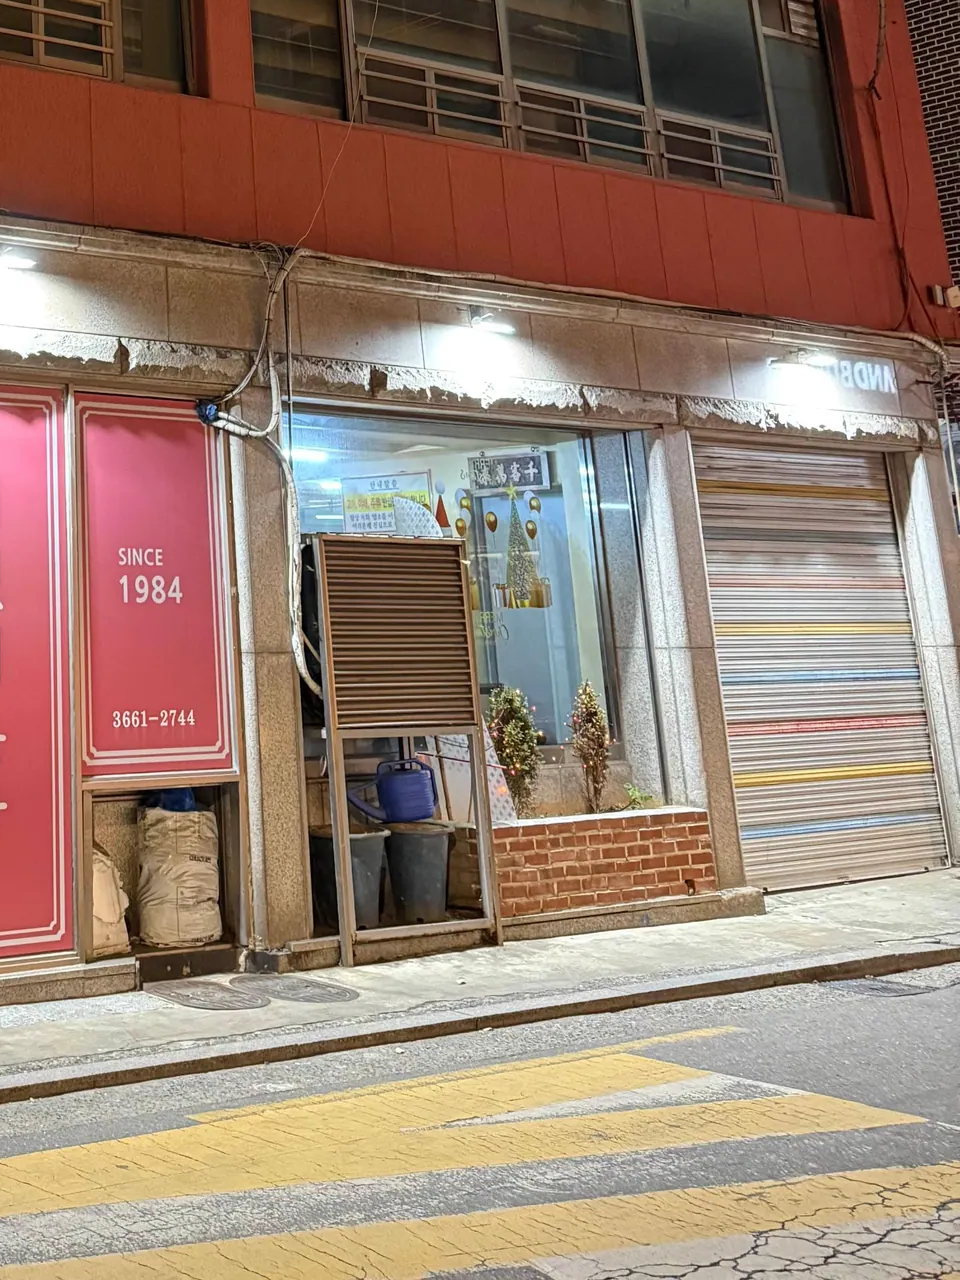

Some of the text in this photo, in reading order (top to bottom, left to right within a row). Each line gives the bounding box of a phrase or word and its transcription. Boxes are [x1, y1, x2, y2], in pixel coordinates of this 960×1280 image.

[118, 547, 164, 566] SINCE
[119, 574, 183, 604] 1984
[112, 709, 195, 728] 3661-2744
